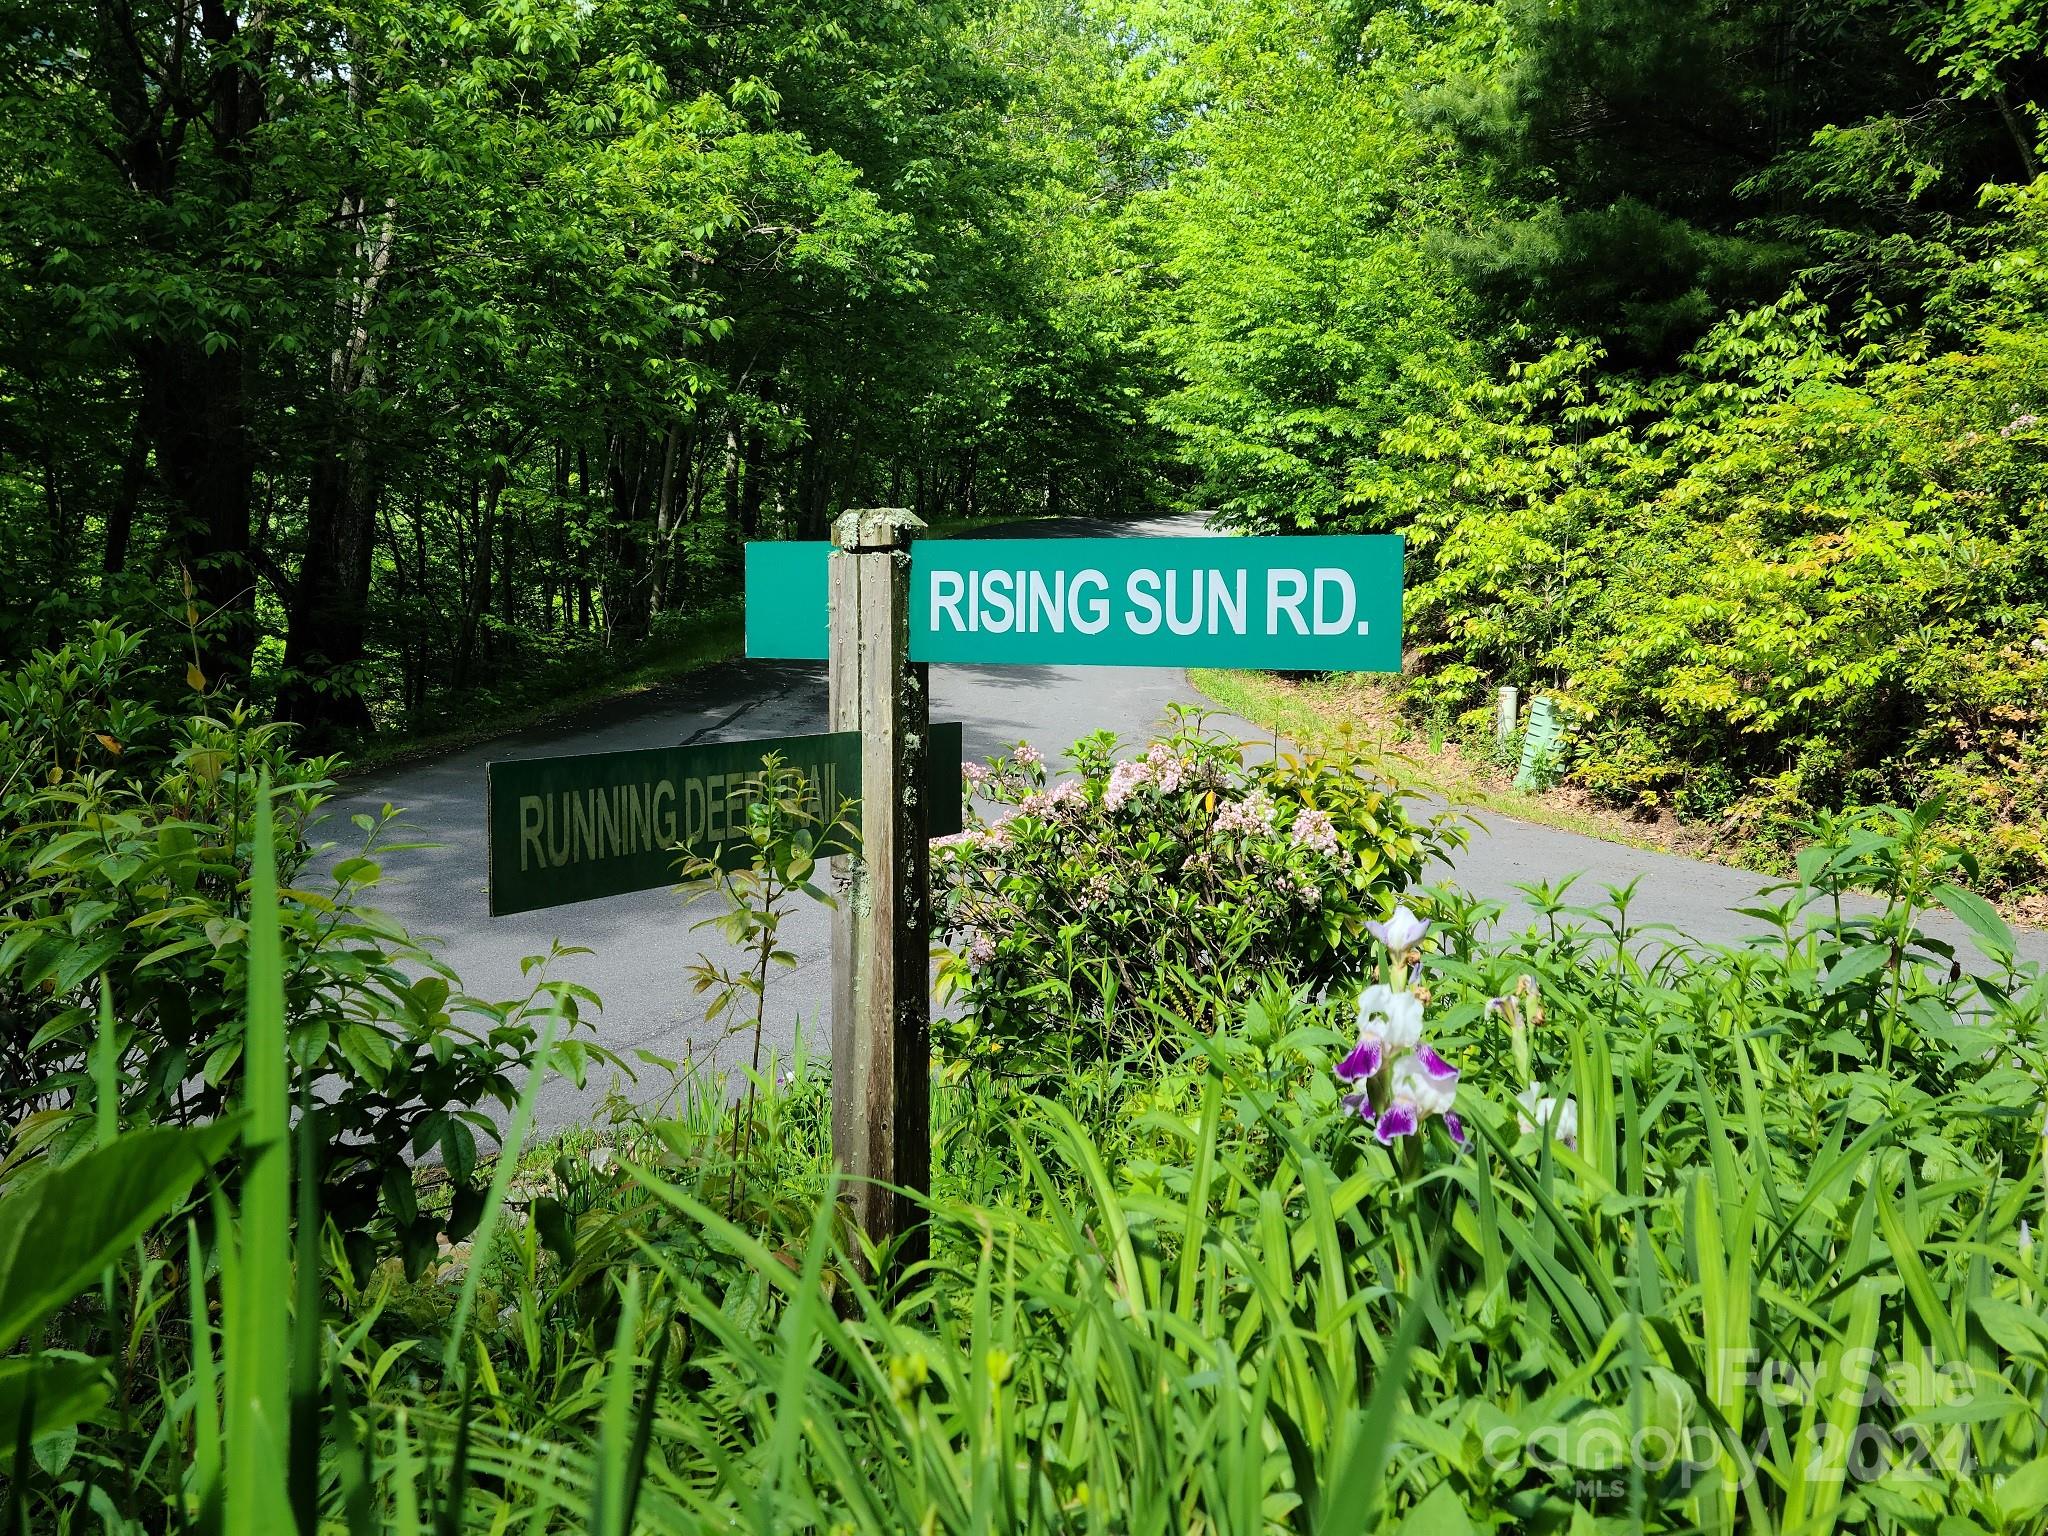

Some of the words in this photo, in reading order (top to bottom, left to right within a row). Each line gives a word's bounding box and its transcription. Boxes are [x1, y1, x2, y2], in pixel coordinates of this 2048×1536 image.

[930, 569, 1110, 635] RISING
[1124, 568, 1247, 636] SUN
[1266, 568, 1369, 636] RD.
[519, 776, 676, 872] RUNNING
